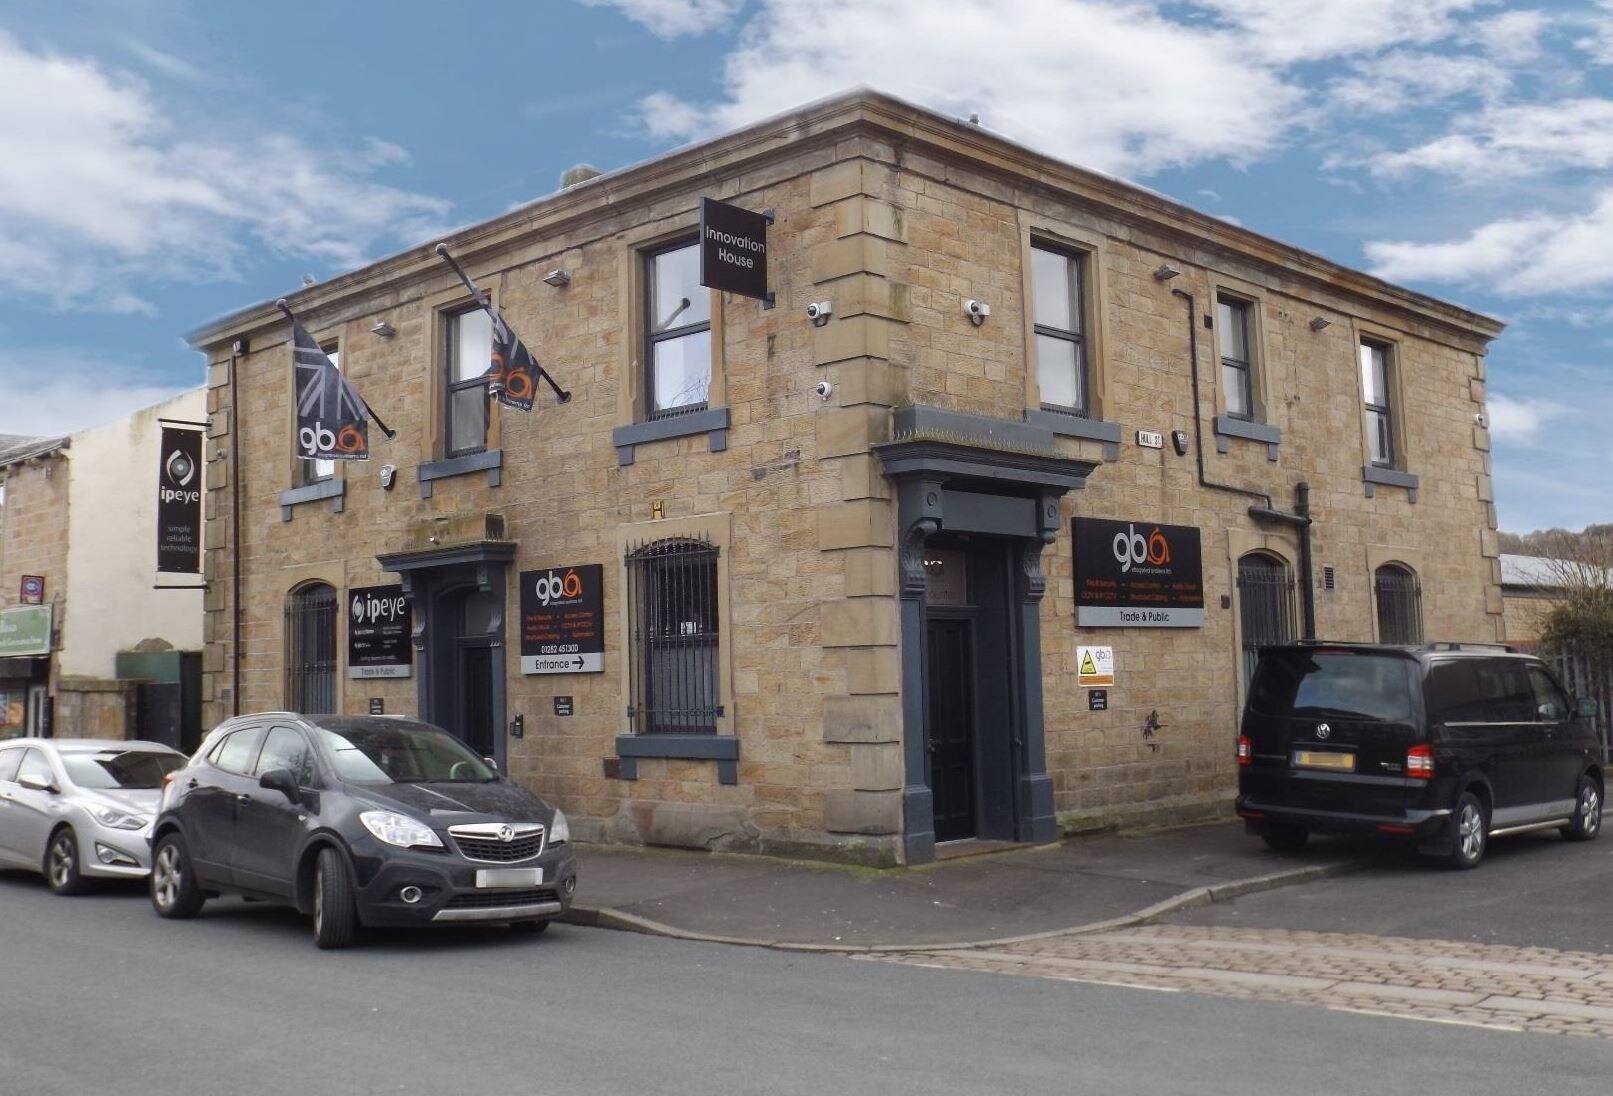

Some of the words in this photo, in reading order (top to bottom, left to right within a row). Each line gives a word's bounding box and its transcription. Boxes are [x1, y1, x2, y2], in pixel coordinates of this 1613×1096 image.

[706, 225, 765, 253] Innovation
[718, 247, 754, 269] House
[161, 485, 200, 504] ipeye
[652, 499, 664, 519] H
[367, 593, 406, 624] ipeye
[1120, 611, 1140, 622] Trade
[1142, 612, 1147, 621] &
[1148, 612, 1170, 622] Public
[541, 645, 558, 654] 01282
[558, 644, 579, 653] 451300
[535, 659, 570, 670] Entrance
